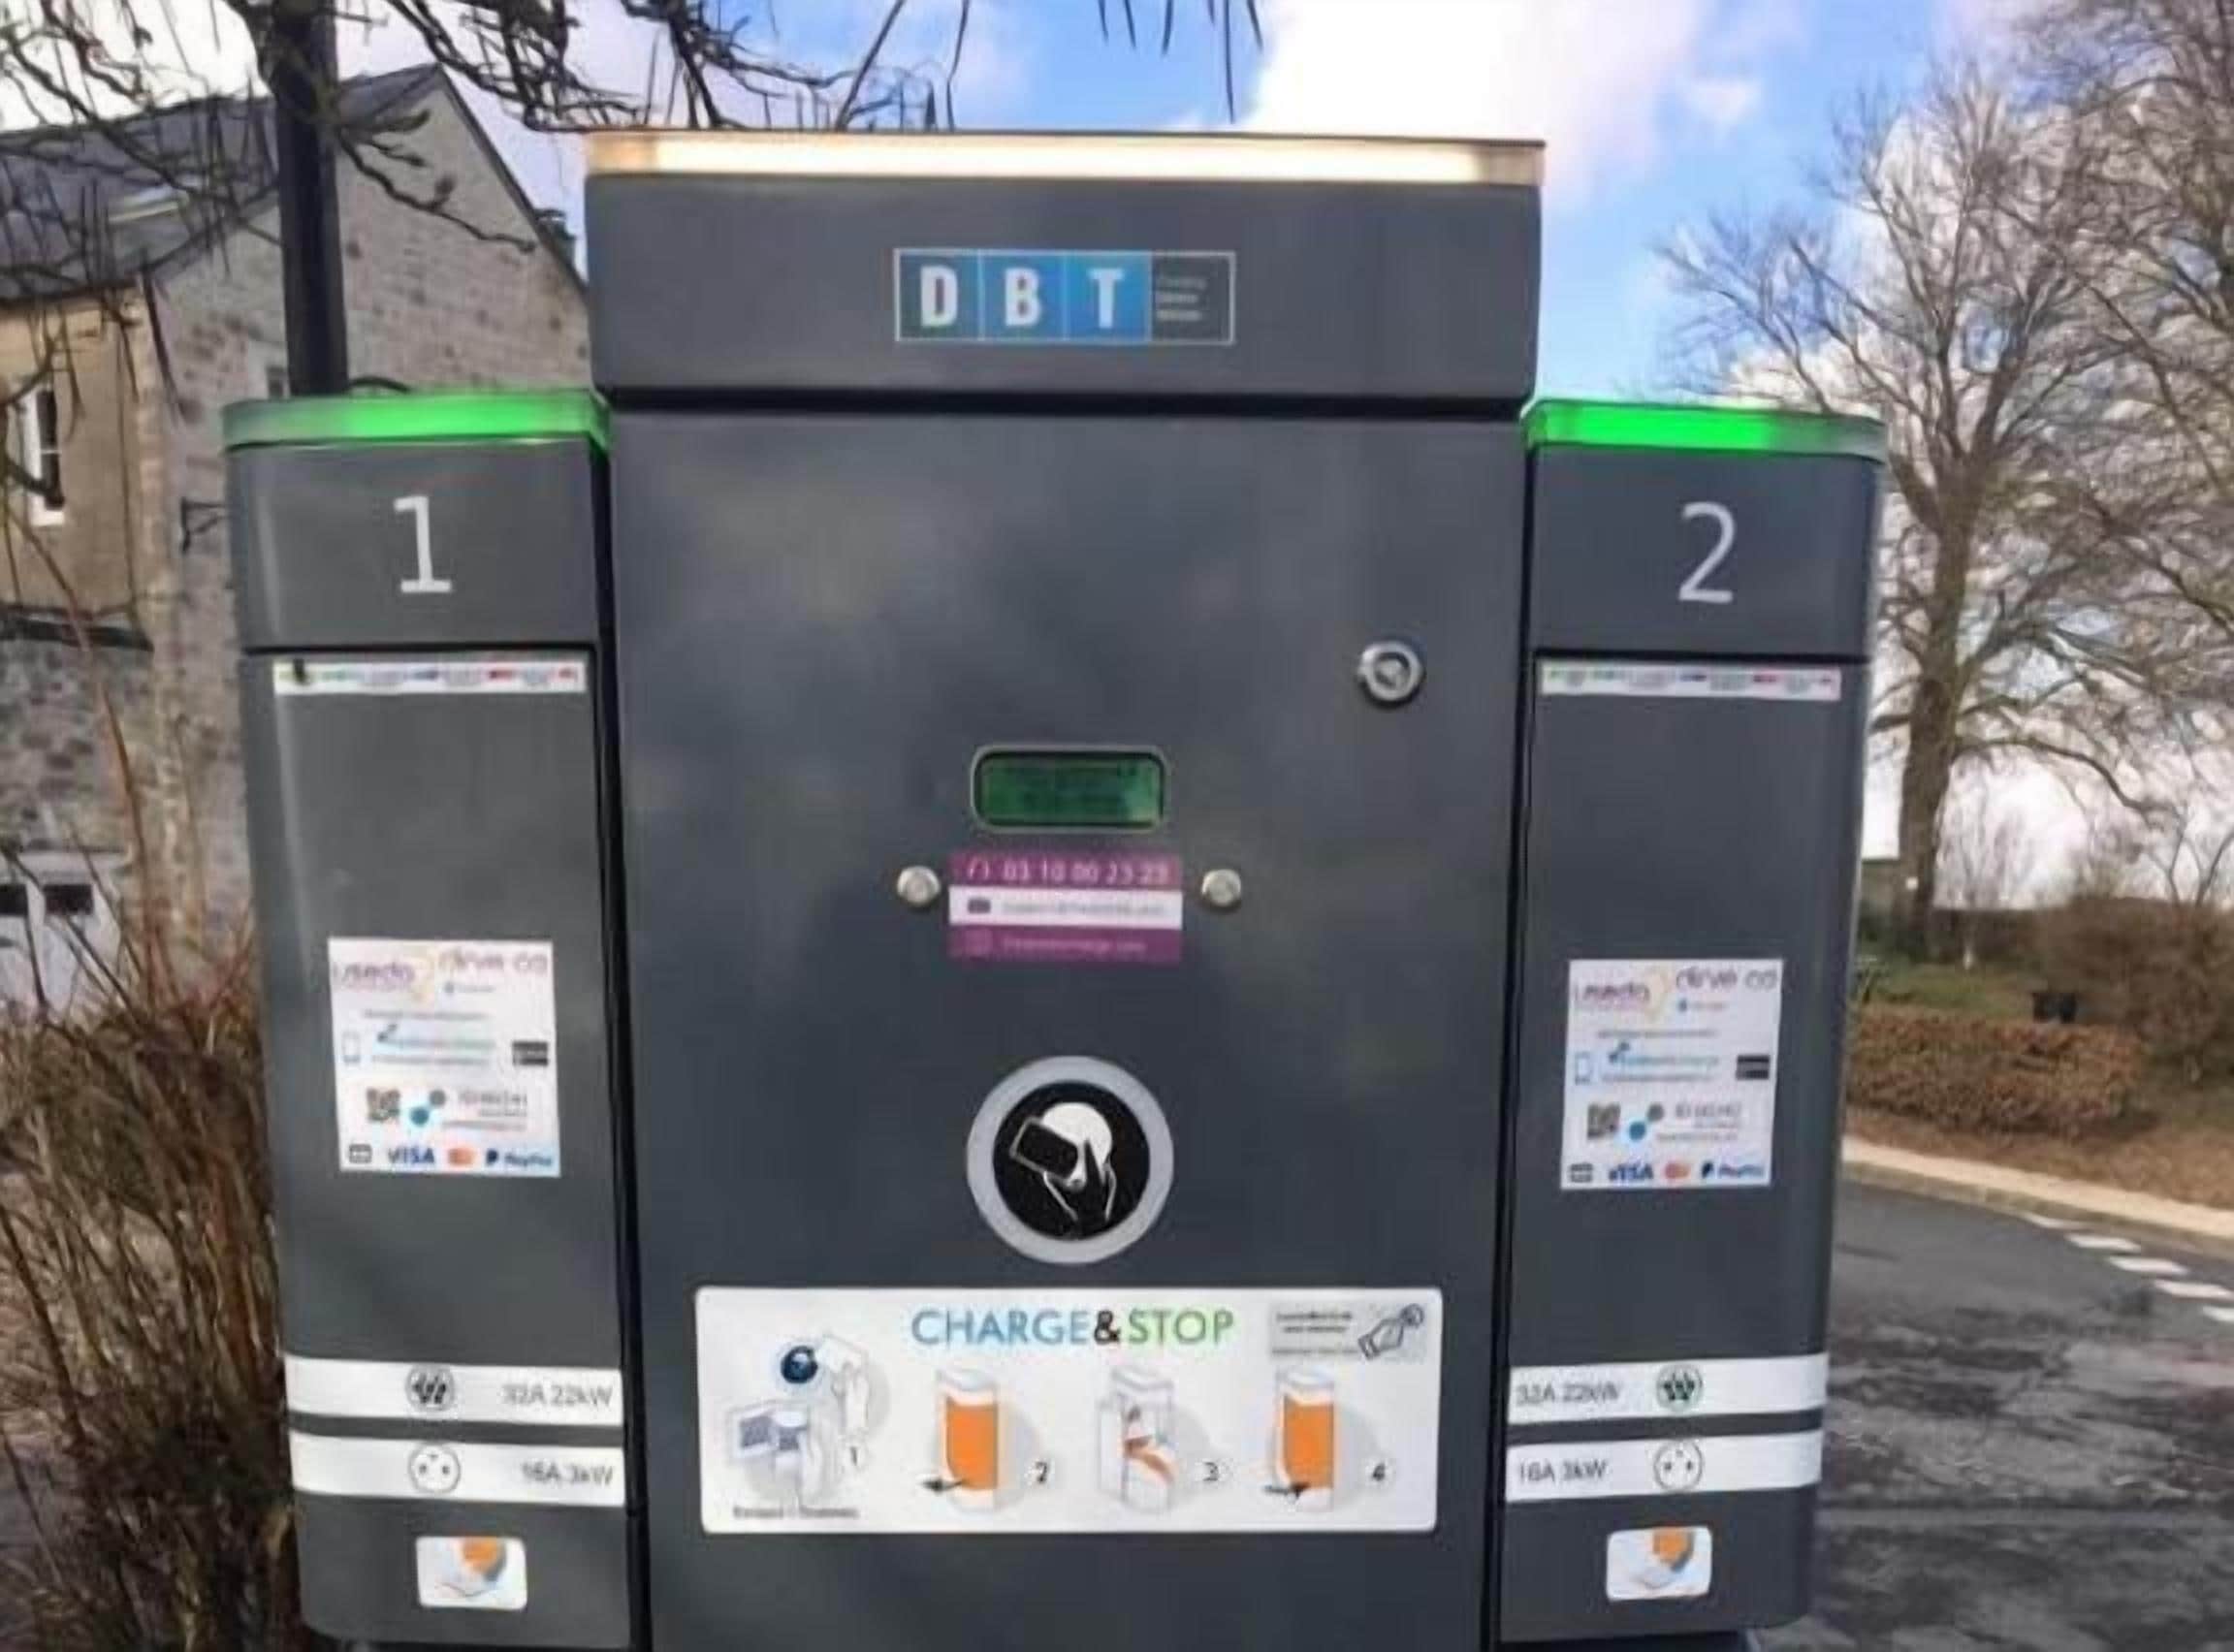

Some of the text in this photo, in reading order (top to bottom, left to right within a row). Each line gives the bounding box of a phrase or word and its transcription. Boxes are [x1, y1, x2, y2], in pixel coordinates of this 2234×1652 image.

[920, 265, 1124, 329] DBT
[394, 495, 453, 593] 1
[1678, 501, 1736, 603] 2
[388, 1145, 435, 1164] VISA
[910, 1308, 1234, 1349] CHARGE&STOP
